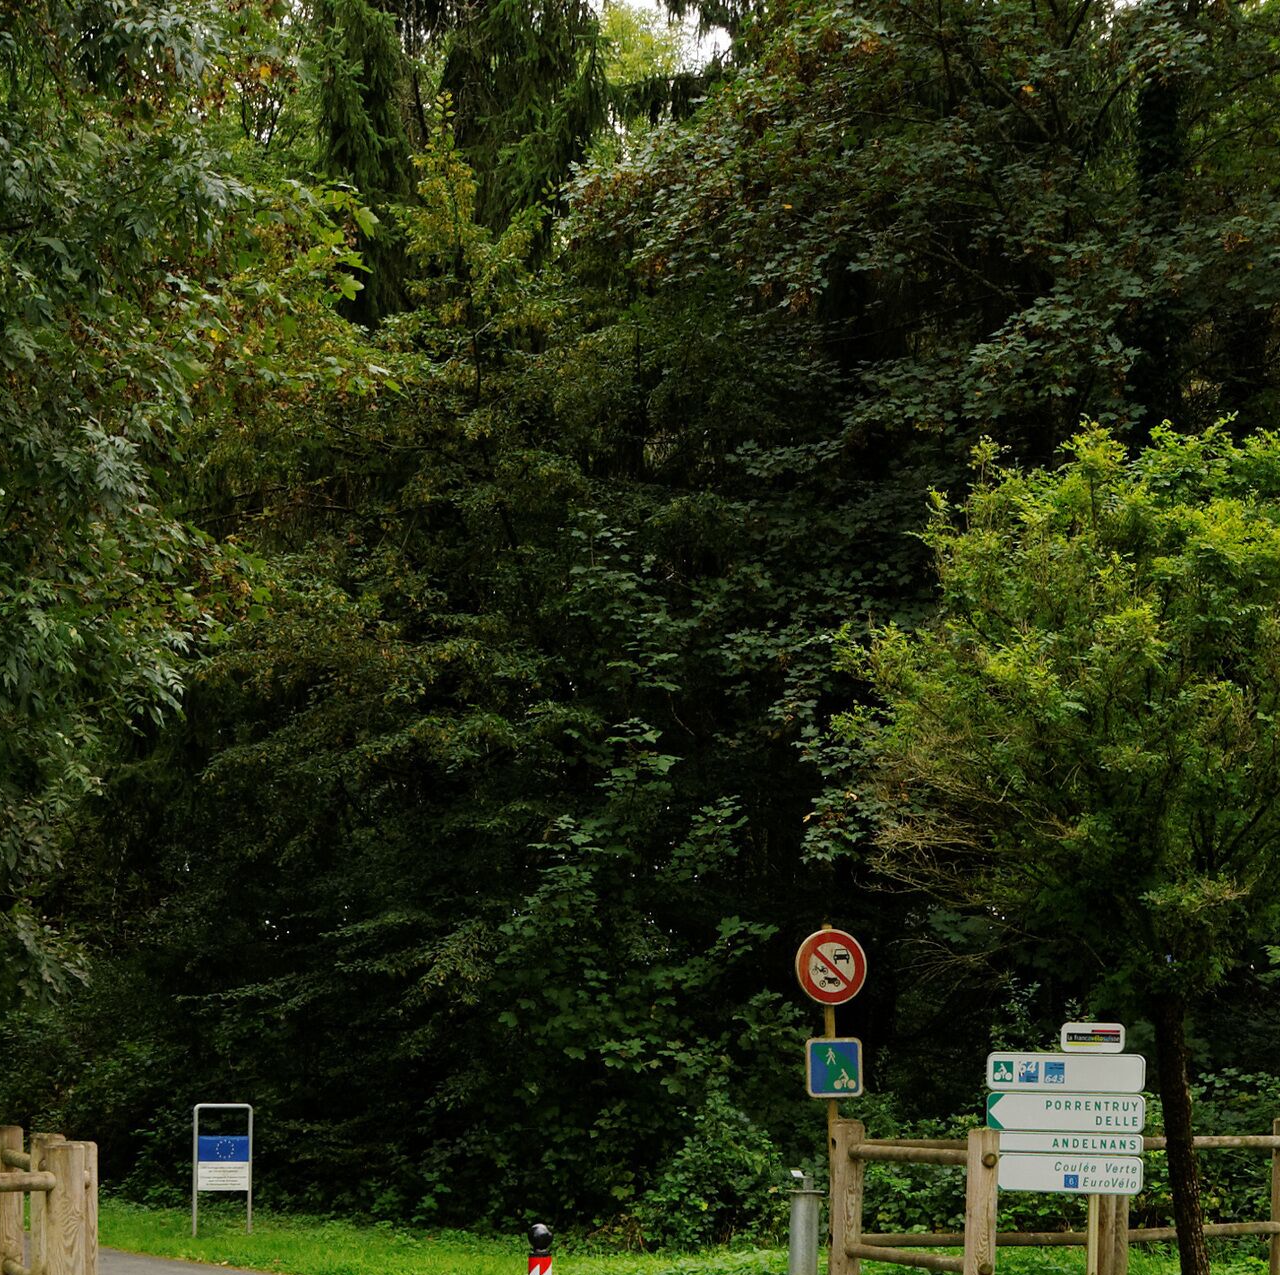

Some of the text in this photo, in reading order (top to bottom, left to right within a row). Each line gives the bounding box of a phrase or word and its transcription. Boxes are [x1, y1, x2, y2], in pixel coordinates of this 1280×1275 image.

[1044, 1075, 1064, 1083] 643
[1045, 1100, 1138, 1112] PORRENTRUY
[1095, 1116, 1138, 1127] DELLE
[1052, 1138, 1137, 1150] ANDELNANS
[1054, 1161, 1138, 1174] Coulée Verte
[1082, 1177, 1137, 1189] EuroVélo
